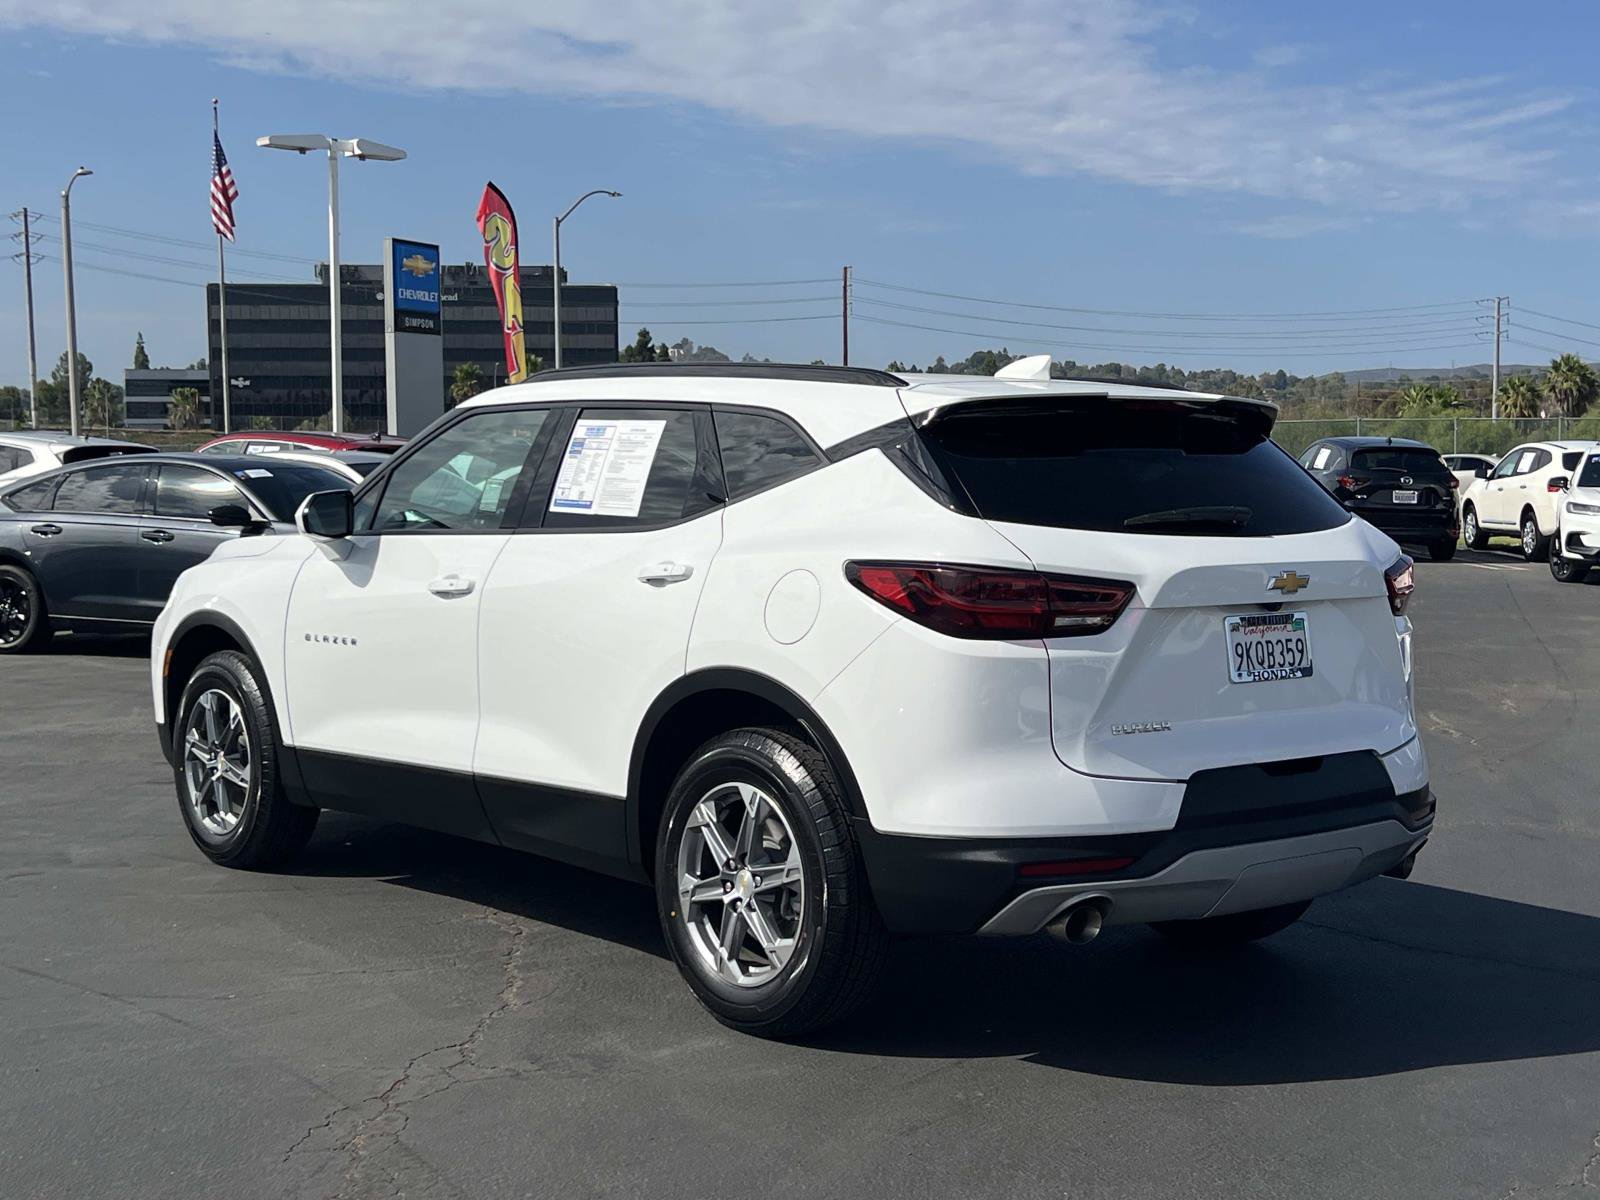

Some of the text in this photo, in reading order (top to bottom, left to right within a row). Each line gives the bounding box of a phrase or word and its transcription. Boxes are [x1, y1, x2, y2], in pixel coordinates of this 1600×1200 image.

[398, 288, 438, 302] CHEVROLET
[404, 317, 434, 328] SIMPSON
[304, 633, 357, 645] BLAZER
[1234, 638, 1305, 672] 9KQB359
[1251, 667, 1297, 682] HONDA
[1111, 721, 1171, 735] BLAZER
